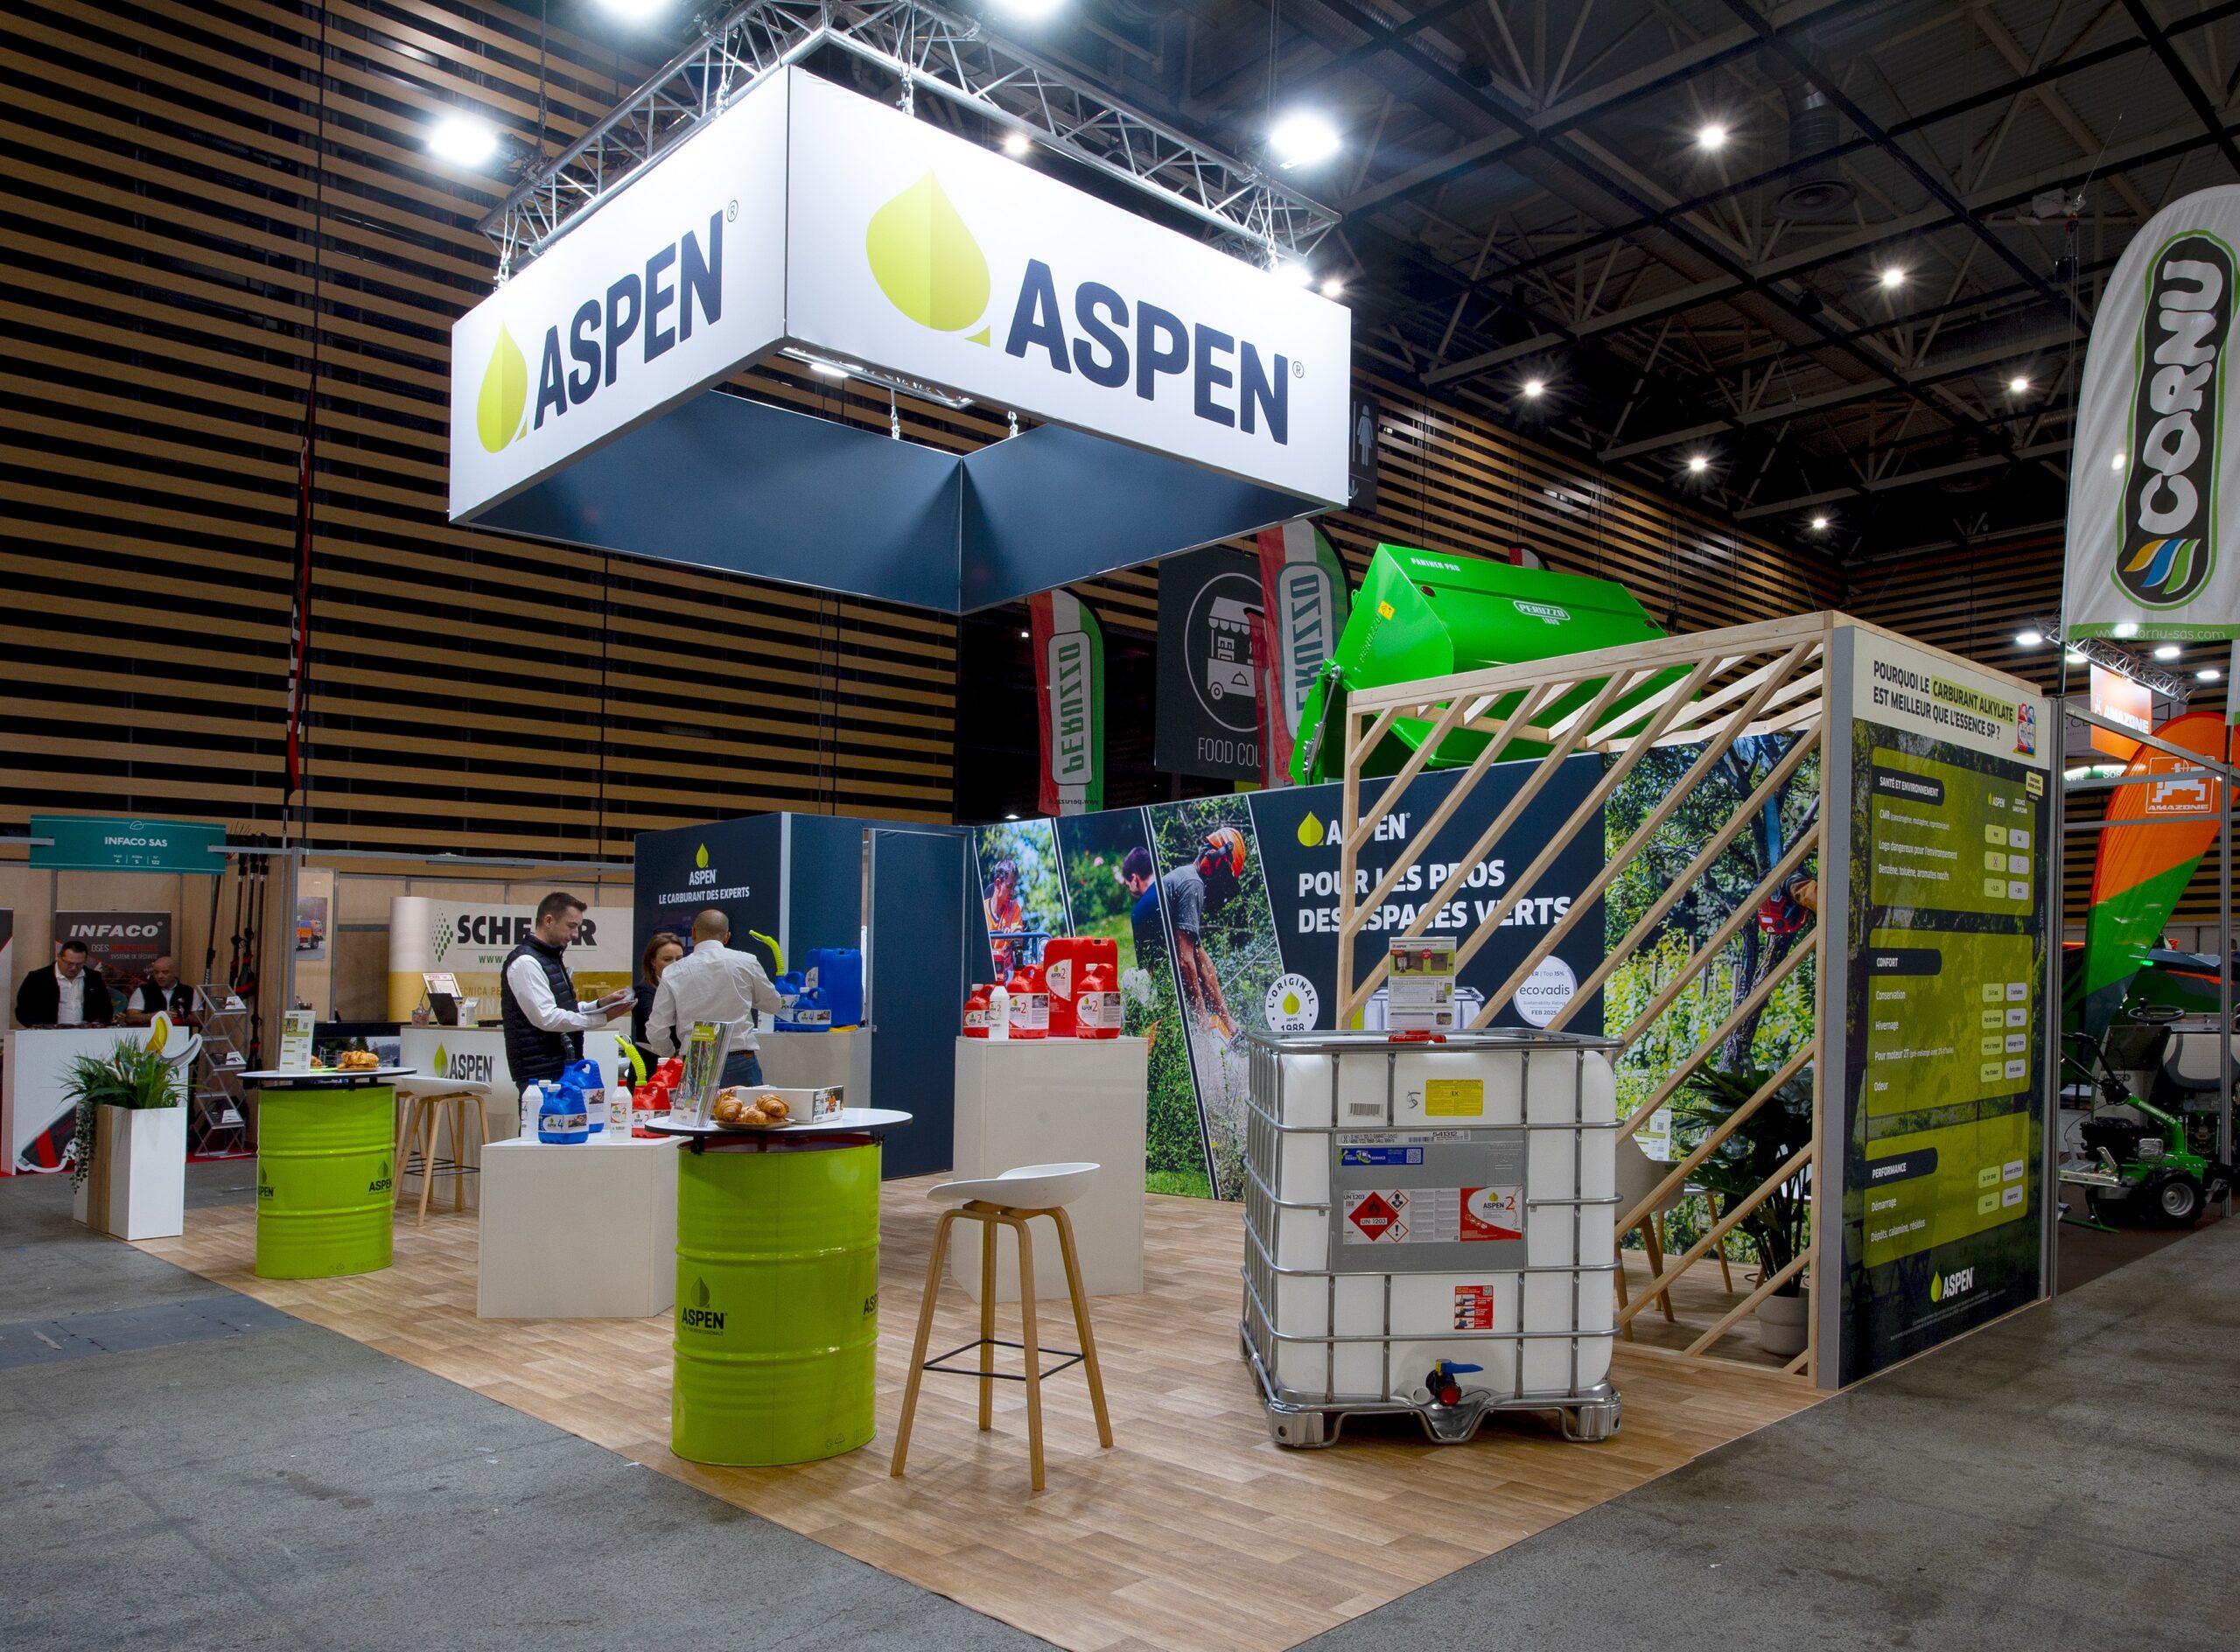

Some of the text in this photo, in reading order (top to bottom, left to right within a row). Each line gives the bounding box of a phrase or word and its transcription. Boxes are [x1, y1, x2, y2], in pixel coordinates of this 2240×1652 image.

[534, 210, 723, 430] ASPEN
[1005, 258, 1288, 445] ASPEN
[2138, 260, 2222, 534] CORNU
[1410, 557, 1460, 572] PANTHER PRO
[1518, 603, 1566, 618] PERUZZO
[1874, 660, 2013, 722] POURQUOI LE CARBURANT ALKYLATE
[1873, 686, 1889, 706] EST
[1891, 691, 1931, 719] MEILLEUR
[1933, 704, 1949, 724] QUE
[1950, 710, 1985, 736] L'ESSENCE
[1987, 722, 1995, 738] SP
[2104, 704, 2149, 734] AMAZONE
[1198, 737, 1261, 767] FOOD COU
[1880, 776, 1894, 788] SANTÉ
[1895, 780, 1901, 789] ET
[1326, 813, 1405, 845] AEN
[105, 836, 167, 847] INFACO SAS
[689, 869, 716, 886] ASPEN
[659, 886, 750, 905] LE CARBURANT DES EXPERTS
[1298, 906, 1340, 934] DES
[1354, 901, 1467, 932] SPAES
[69, 924, 159, 937] INFACO
[458, 915, 597, 946] SCHER
[1877, 957, 1899, 967] CONFORT
[1061, 969, 1067, 979] 2
[1268, 977, 1315, 1008] L'ORIGINAL
[1520, 984, 1570, 995] ecovadis
[1876, 990, 1906, 1000] Conservation
[1021, 1002, 1026, 1014] 2
[1092, 1000, 1098, 1012] 2
[977, 1014, 982, 1024] 2
[1875, 1020, 1899, 1031] Hivernage
[1875, 1051, 1886, 1060] Pour
[449, 1054, 492, 1082] ASPEN
[1874, 1082, 1888, 1092] Odeur
[1872, 1162, 1907, 1179] PERFORMANCE
[1505, 1196, 1515, 1210] 2
[1872, 1198, 1897, 1212] Démarrage
[1942, 1266, 1973, 1300] ASPEN
[682, 1307, 724, 1329] ASPEN
